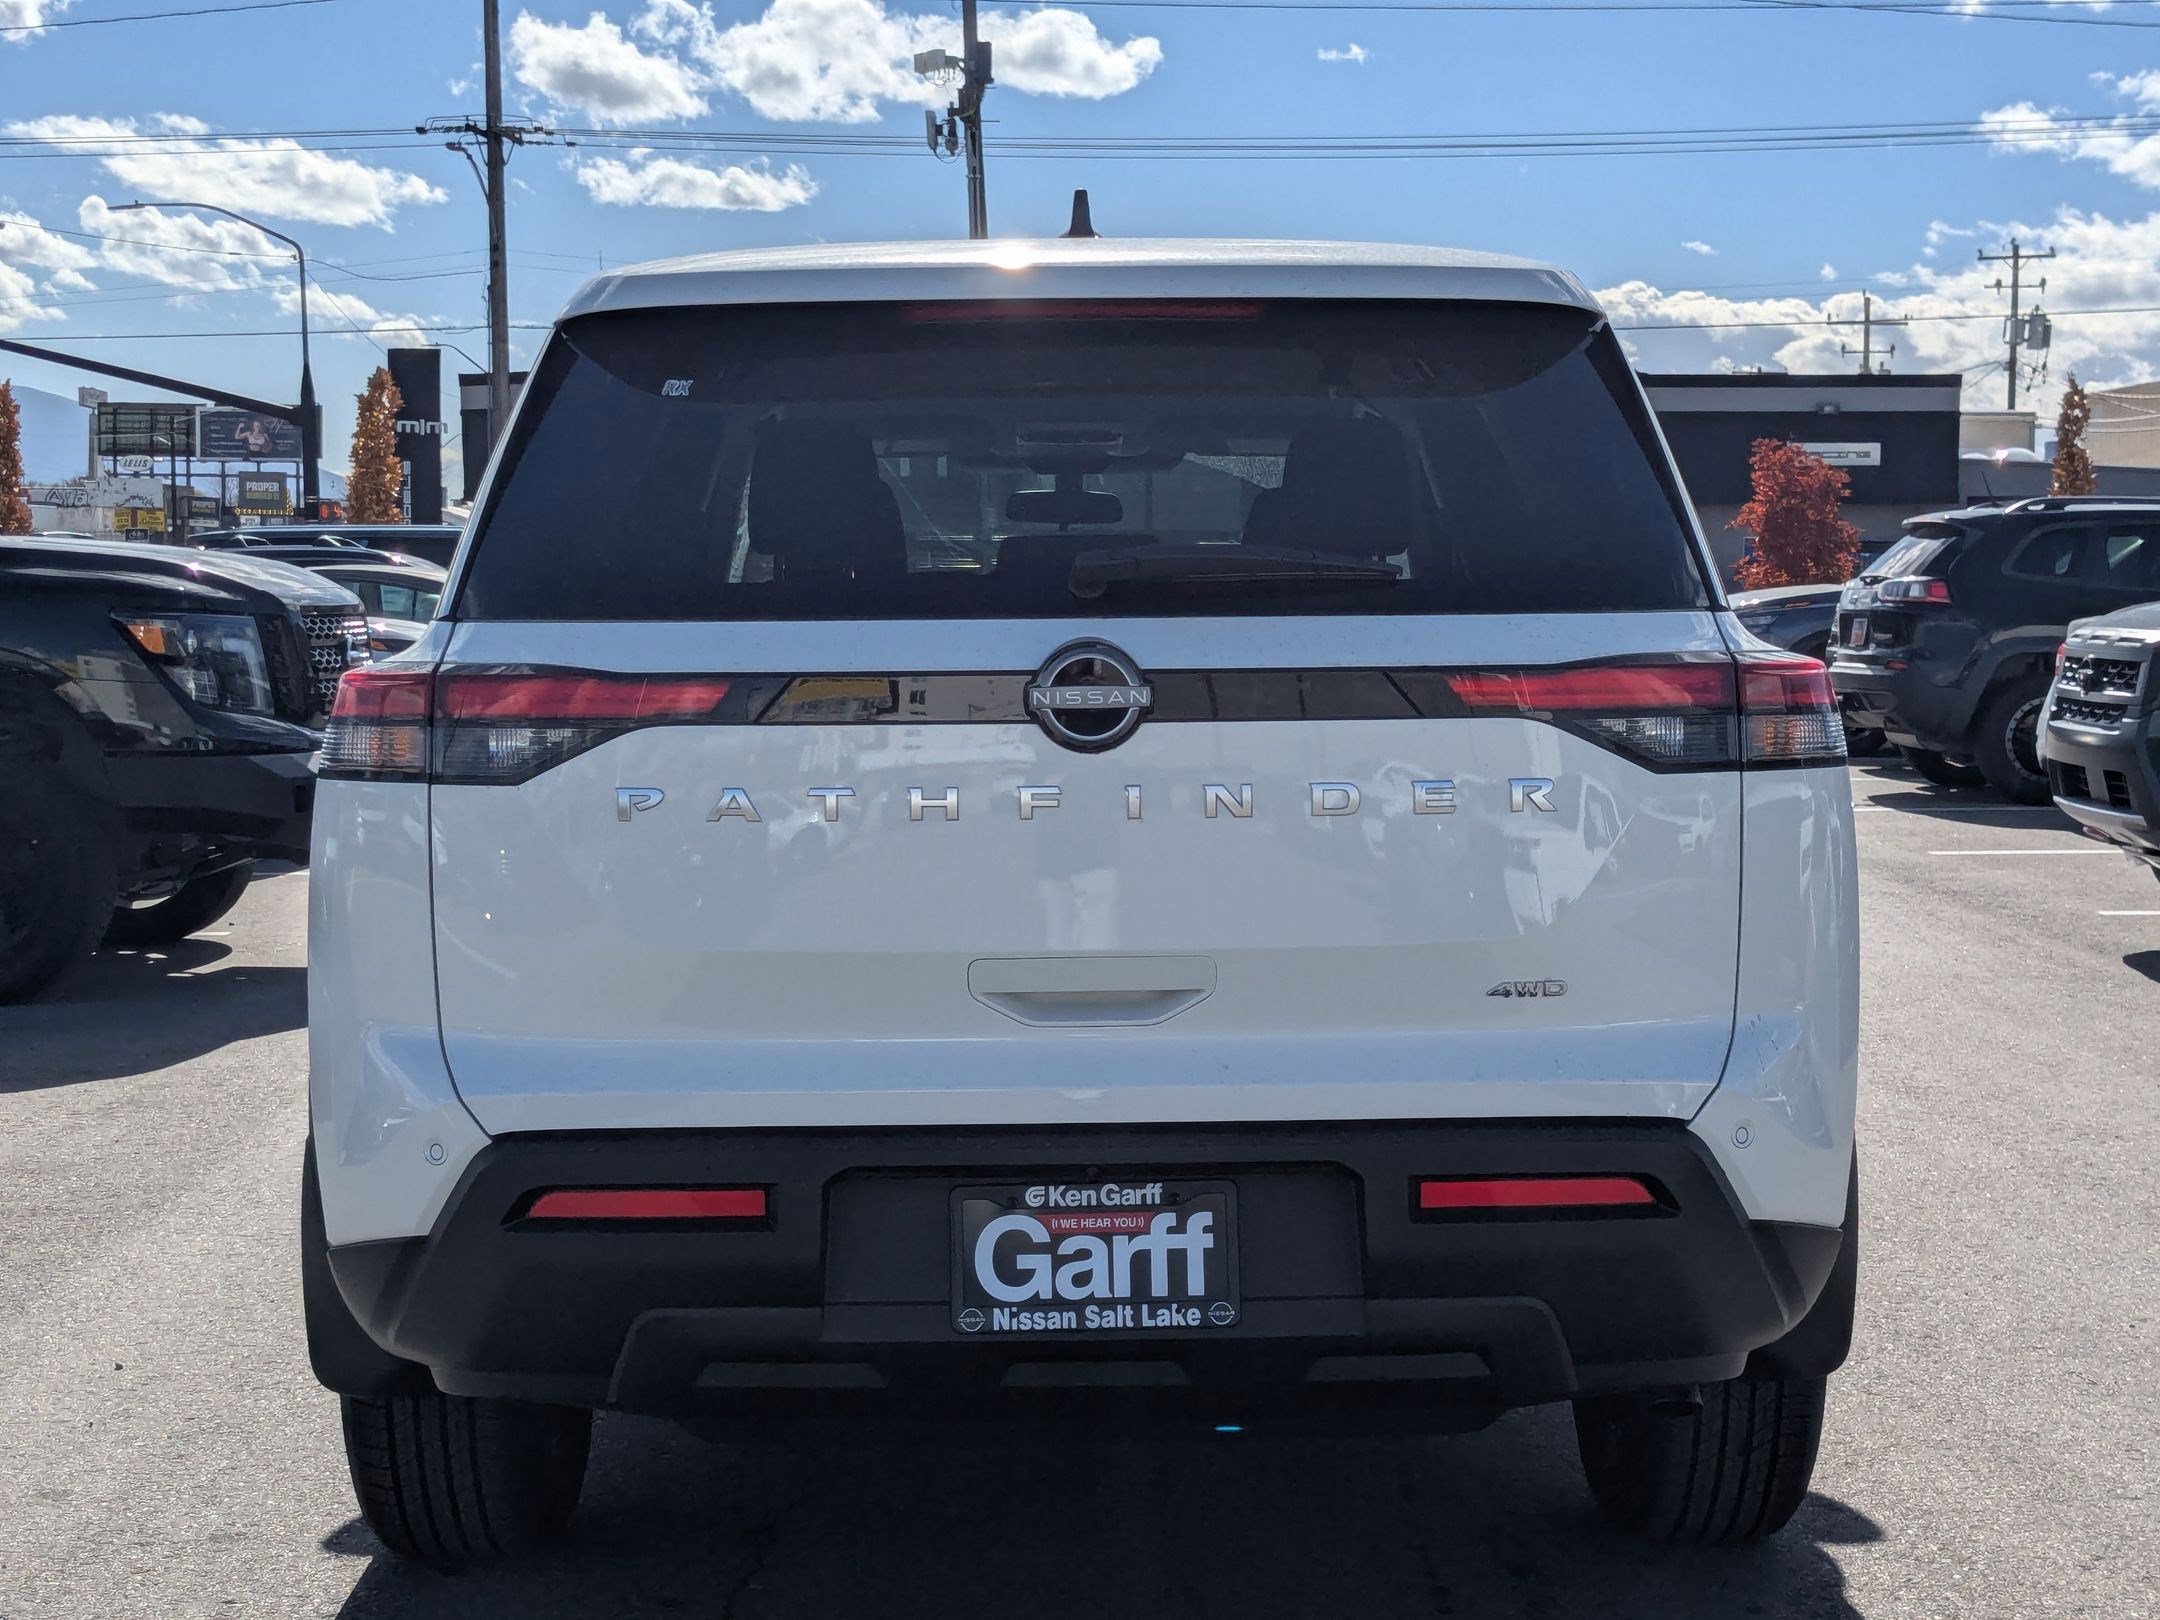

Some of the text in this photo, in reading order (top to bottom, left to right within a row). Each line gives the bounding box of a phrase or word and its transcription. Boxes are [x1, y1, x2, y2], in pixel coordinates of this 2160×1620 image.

[661, 379, 694, 396] RX
[123, 459, 149, 468] LELIS
[246, 482, 280, 492] PROPER
[1033, 689, 1147, 705] NISSAN
[615, 778, 1557, 822] PATHFINDER
[1486, 979, 1568, 998] 4WD
[1049, 1183, 1163, 1207] Ken Garff
[1060, 1216, 1137, 1229] WE HEAR YOU
[974, 1211, 1214, 1303] Garff
[993, 1302, 1201, 1331] Nissan Salt Lake
